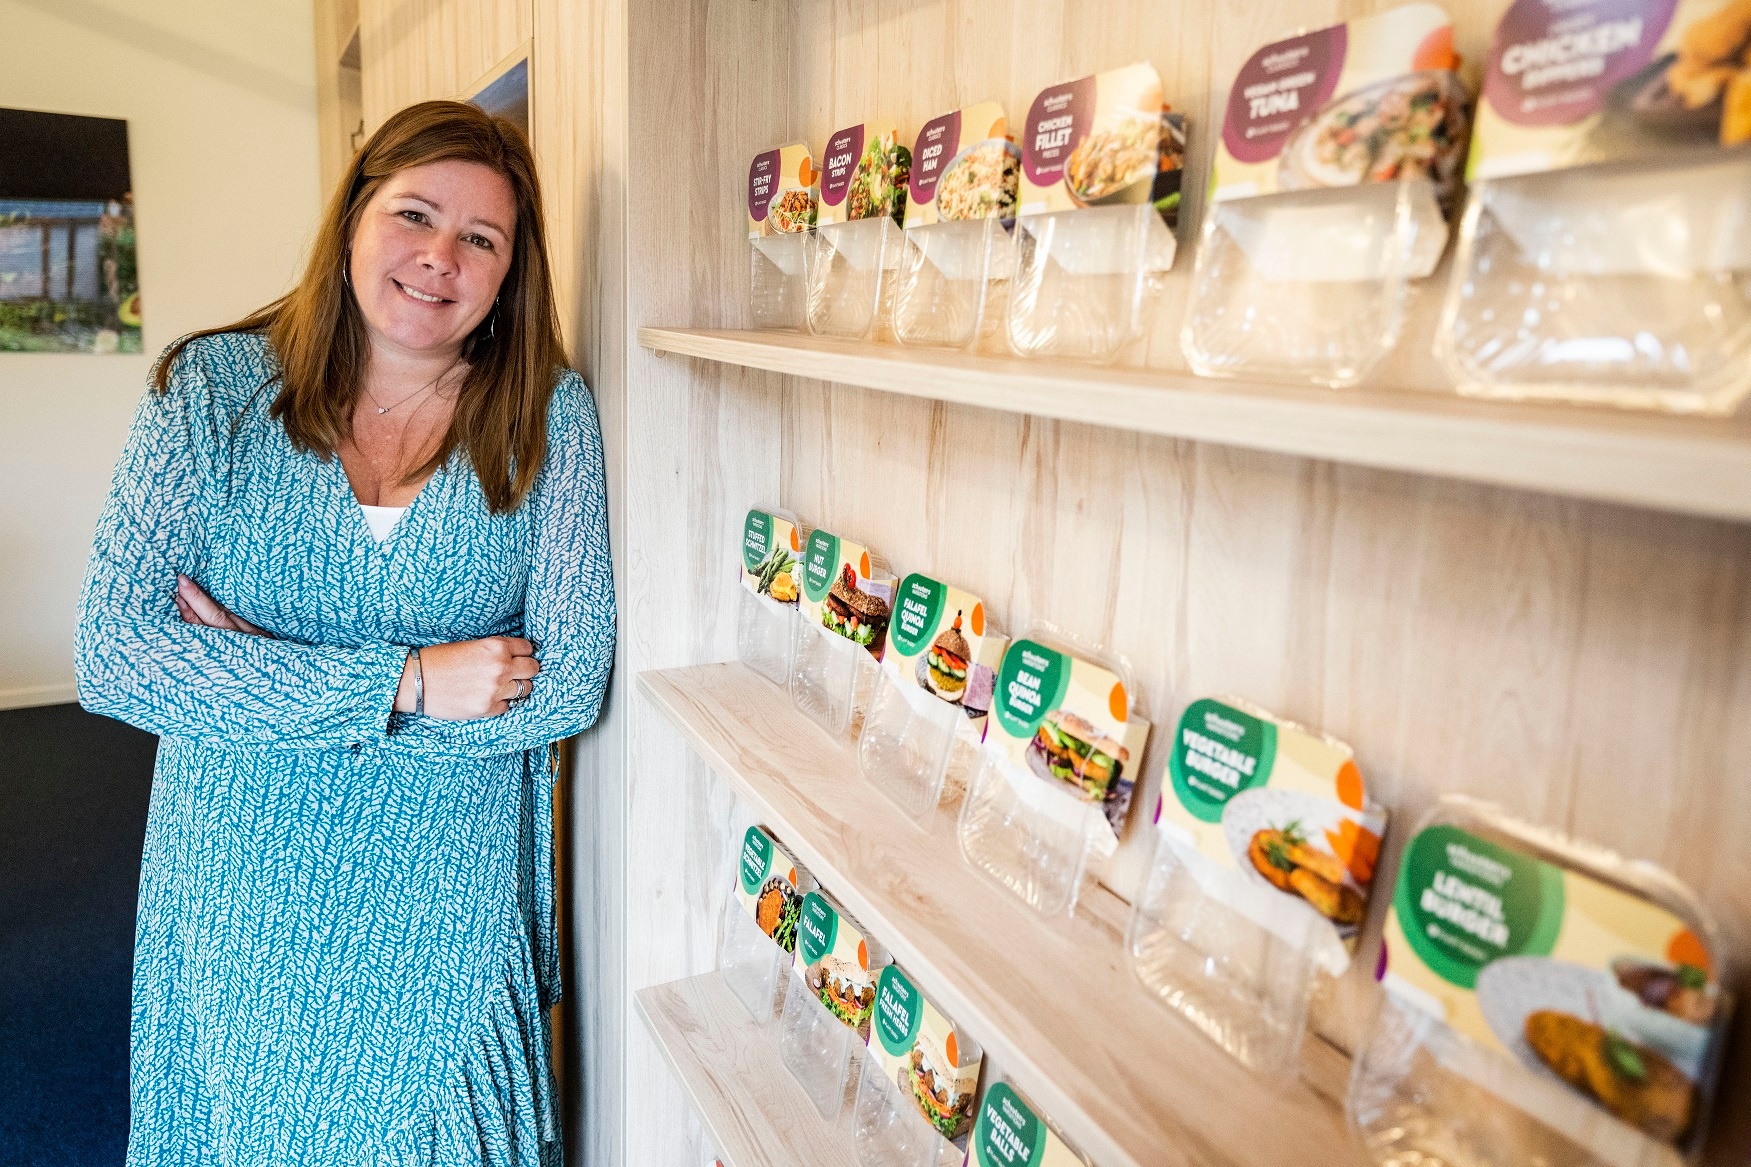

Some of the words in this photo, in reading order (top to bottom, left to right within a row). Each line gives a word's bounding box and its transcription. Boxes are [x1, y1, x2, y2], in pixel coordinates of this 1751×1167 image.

[1502, 17, 1643, 75] CHICKEN
[1250, 89, 1299, 119] TUNA
[1038, 115, 1073, 132] CHICKEN
[1035, 127, 1072, 151] FILLET
[829, 153, 852, 169] BACON
[922, 144, 942, 160] DICED
[832, 167, 846, 177] STRIPS
[922, 158, 938, 172] HAM
[754, 174, 772, 186] STIR-FRY
[754, 185, 768, 196] STRIPS
[746, 538, 766, 554] SCHNITZEL
[748, 530, 765, 543] STUFFED
[808, 562, 826, 578] BURGER
[814, 554, 824, 565] NUT
[904, 598, 927, 617] FALAFEL
[901, 609, 924, 629] QUINOA
[901, 622, 918, 636] BURGER
[1017, 669, 1041, 691] BEAN
[1008, 681, 1041, 707] QUINOA
[1009, 696, 1034, 716] BURGER
[1183, 728, 1256, 777] VEGETABLE
[1185, 749, 1241, 790] BURGER
[743, 852, 762, 879] SCHNITZEL
[745, 842, 765, 870] VEGETABLE
[1432, 870, 1505, 923] LENTIL
[1420, 888, 1510, 949] BURGER
[803, 915, 825, 947] FALAFEL
[879, 998, 892, 1020] FRESH
[892, 1014, 908, 1037] HERBS
[881, 986, 909, 1027] FALAFEL
[987, 1103, 1030, 1162] VEGETABLE
[990, 1128, 1014, 1162] BALLS
